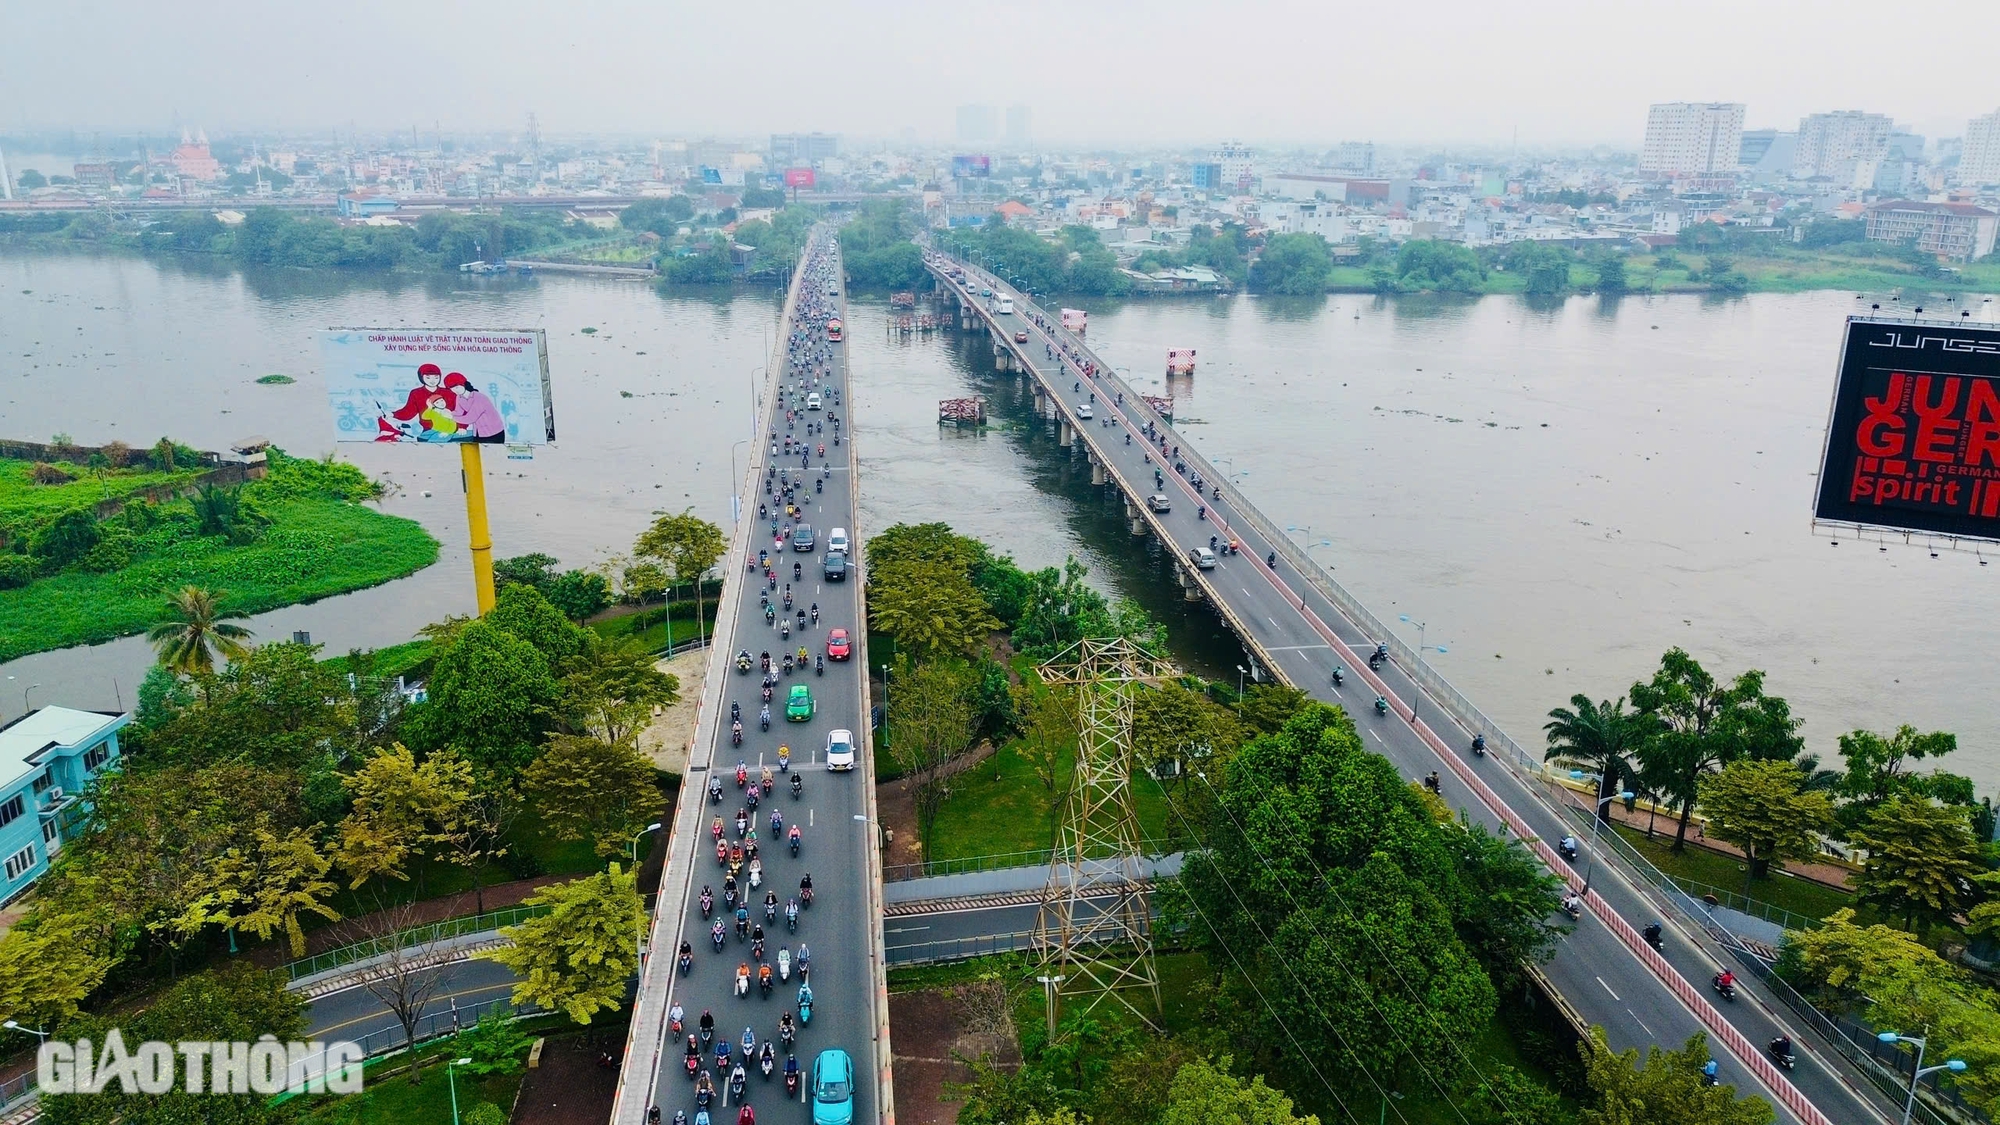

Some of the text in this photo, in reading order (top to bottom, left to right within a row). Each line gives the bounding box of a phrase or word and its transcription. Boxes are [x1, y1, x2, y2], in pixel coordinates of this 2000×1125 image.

[368, 334, 386, 343] CHẤP
[387, 335, 407, 343] HÀNH
[407, 335, 424, 344] LUẬT
[435, 335, 451, 344] TRẬT
[474, 336, 491, 344] TOÀN
[509, 337, 533, 345] THÔNG
[398, 344, 417, 352] DỰNG
[433, 344, 451, 352] SỐNG
[500, 346, 523, 354] THÔNG
[1899, 376, 1913, 414] GERMAN
[1956, 422, 1970, 458] JUNGER
[1854, 472, 1960, 505] spirit
